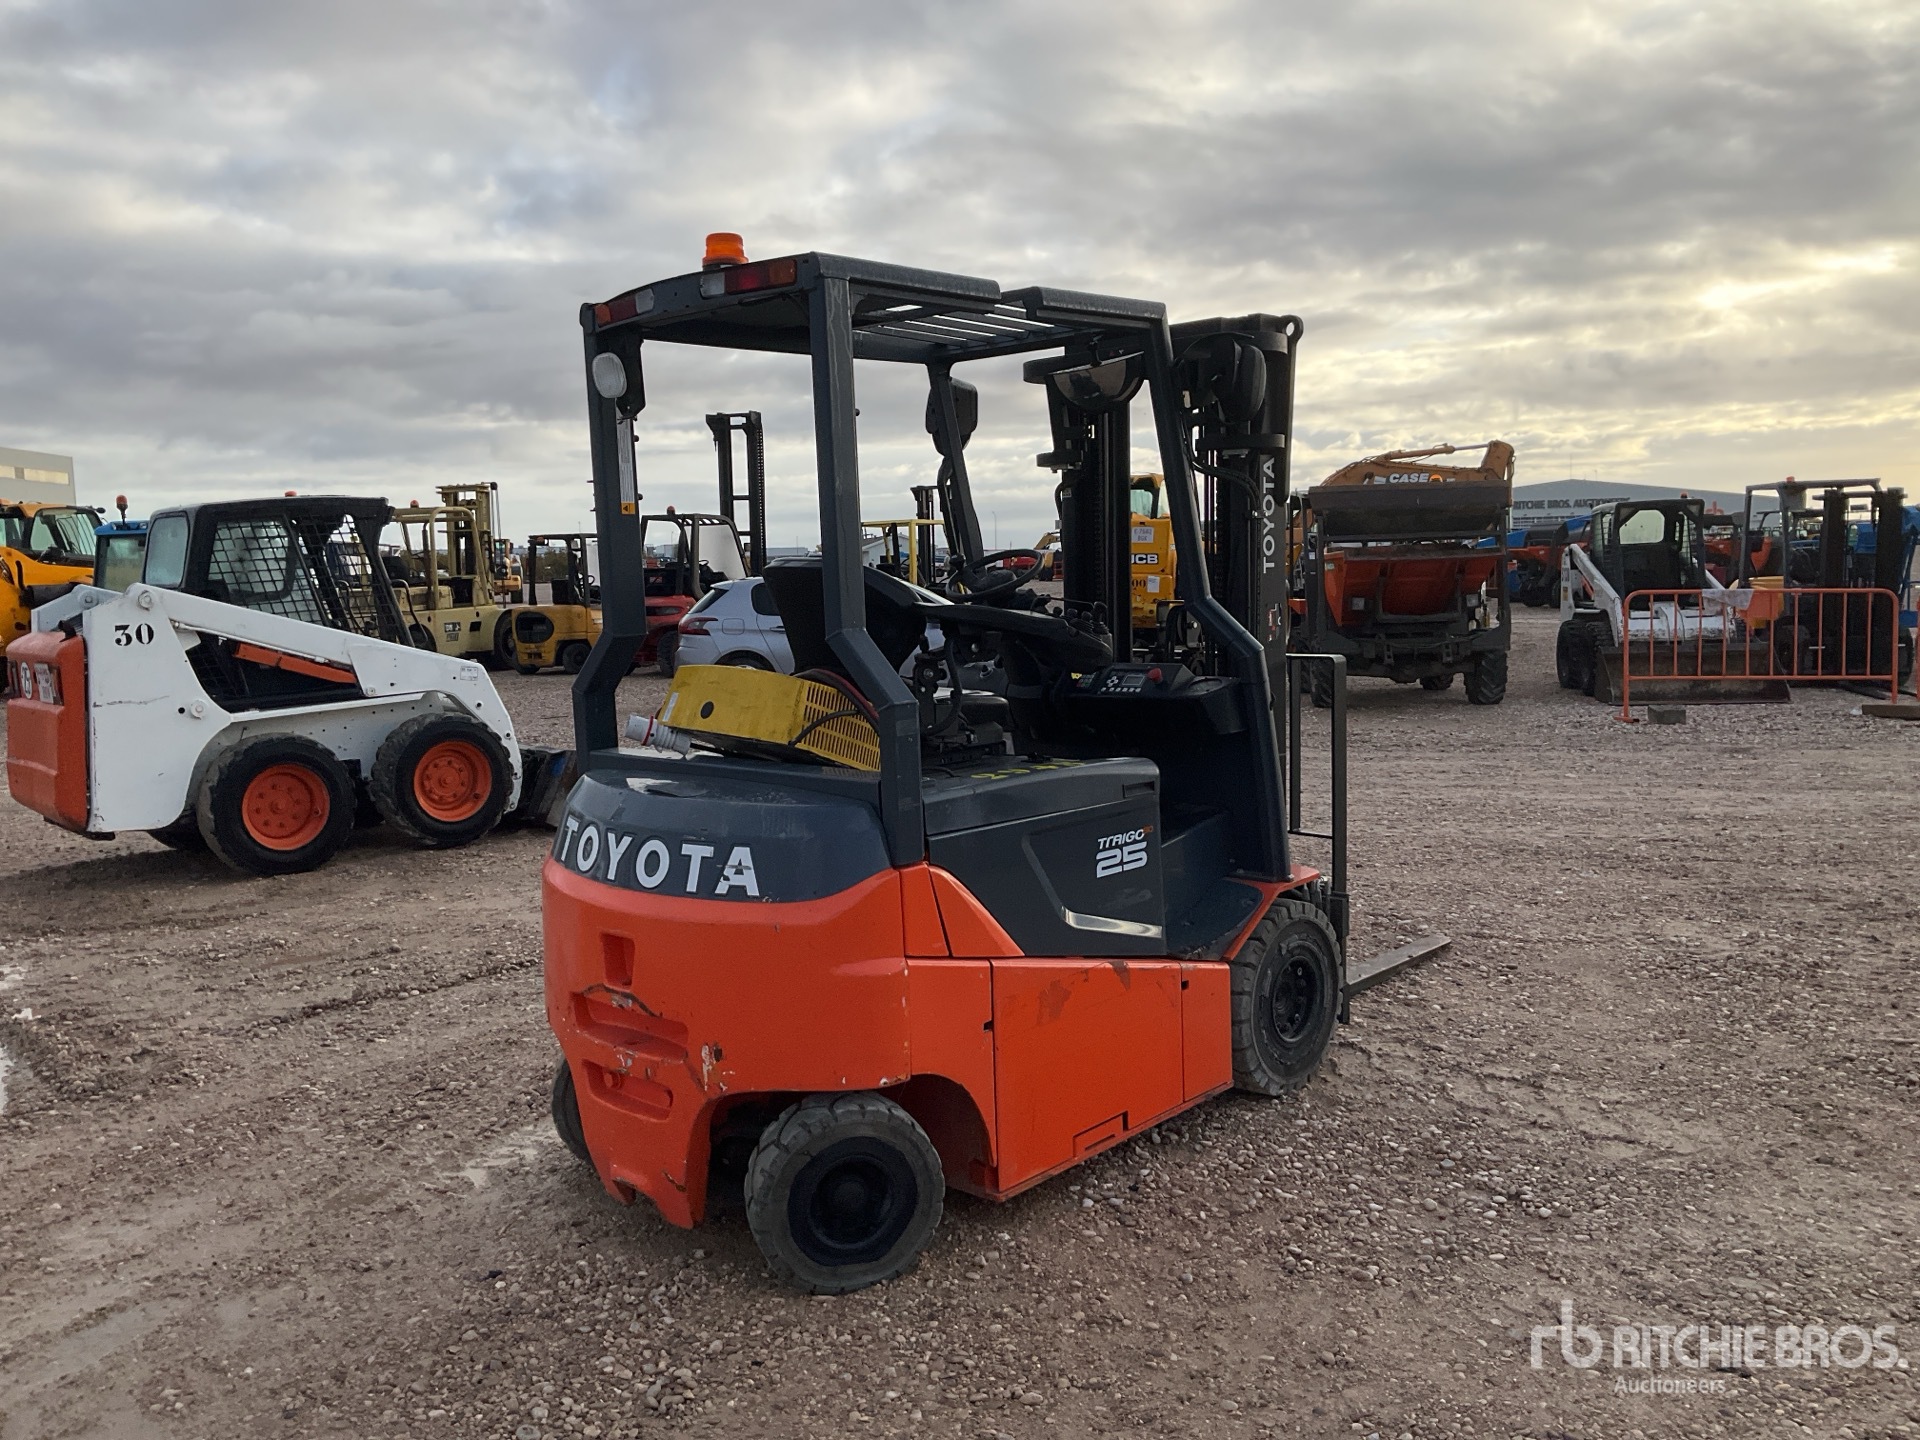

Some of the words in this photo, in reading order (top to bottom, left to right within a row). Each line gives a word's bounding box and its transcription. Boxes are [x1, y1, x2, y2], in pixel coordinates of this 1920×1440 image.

[1389, 473, 1430, 484] CASE
[1262, 457, 1275, 574] TOYOTA
[1512, 500, 1546, 510] RITCHIE
[1547, 499, 1572, 509] BROS.
[114, 623, 155, 647] 30
[560, 815, 760, 897] TOYOTA
[1095, 841, 1148, 879] 25
